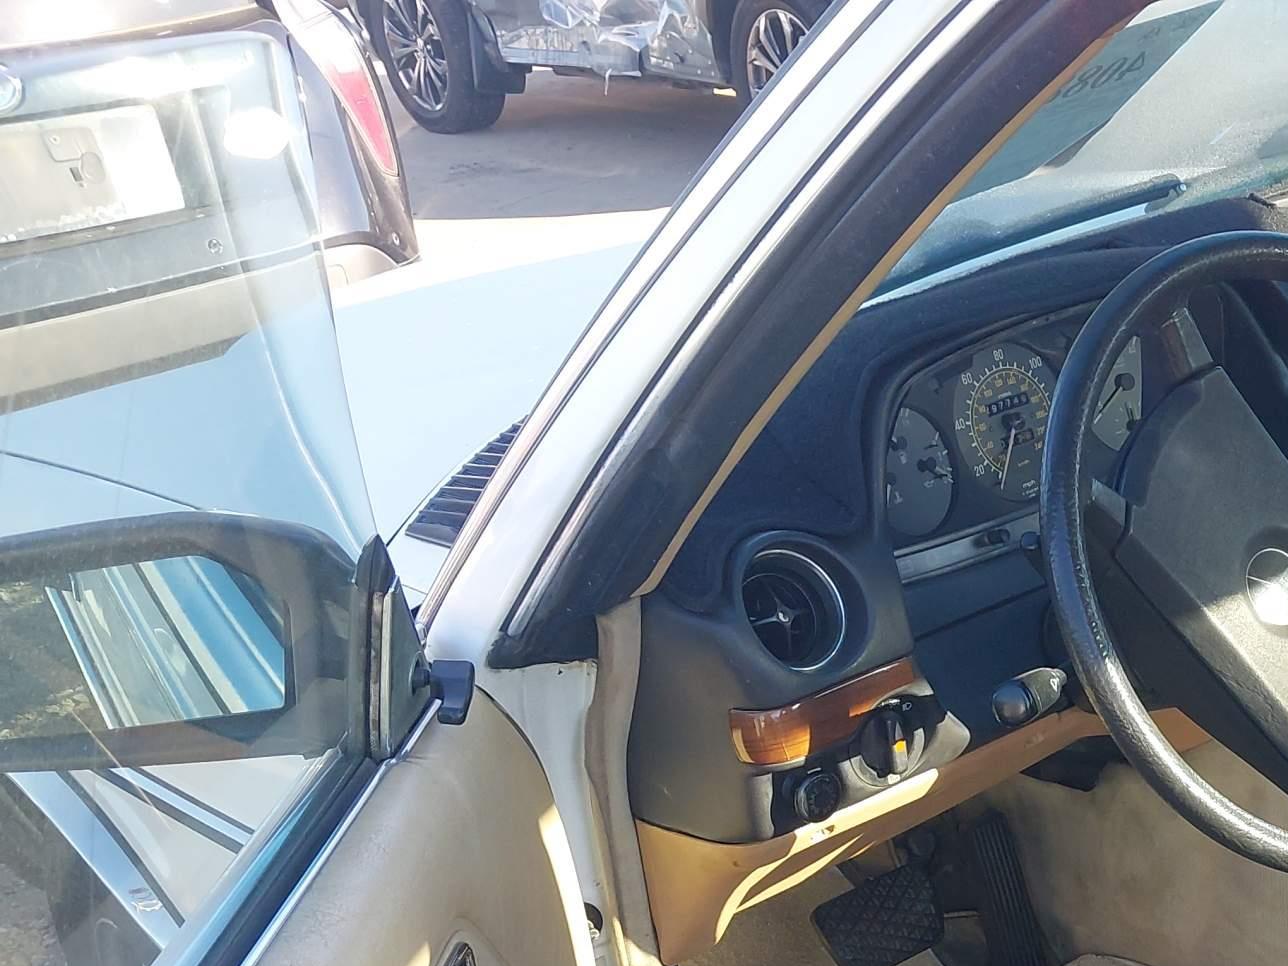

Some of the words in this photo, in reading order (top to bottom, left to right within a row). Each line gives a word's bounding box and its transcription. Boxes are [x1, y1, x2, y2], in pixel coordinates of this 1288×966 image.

[992, 348, 1004, 361] 80
[1028, 356, 1043, 369] 100
[961, 372, 973, 385] 60
[955, 418, 966, 431] 40
[974, 464, 985, 477] 20
